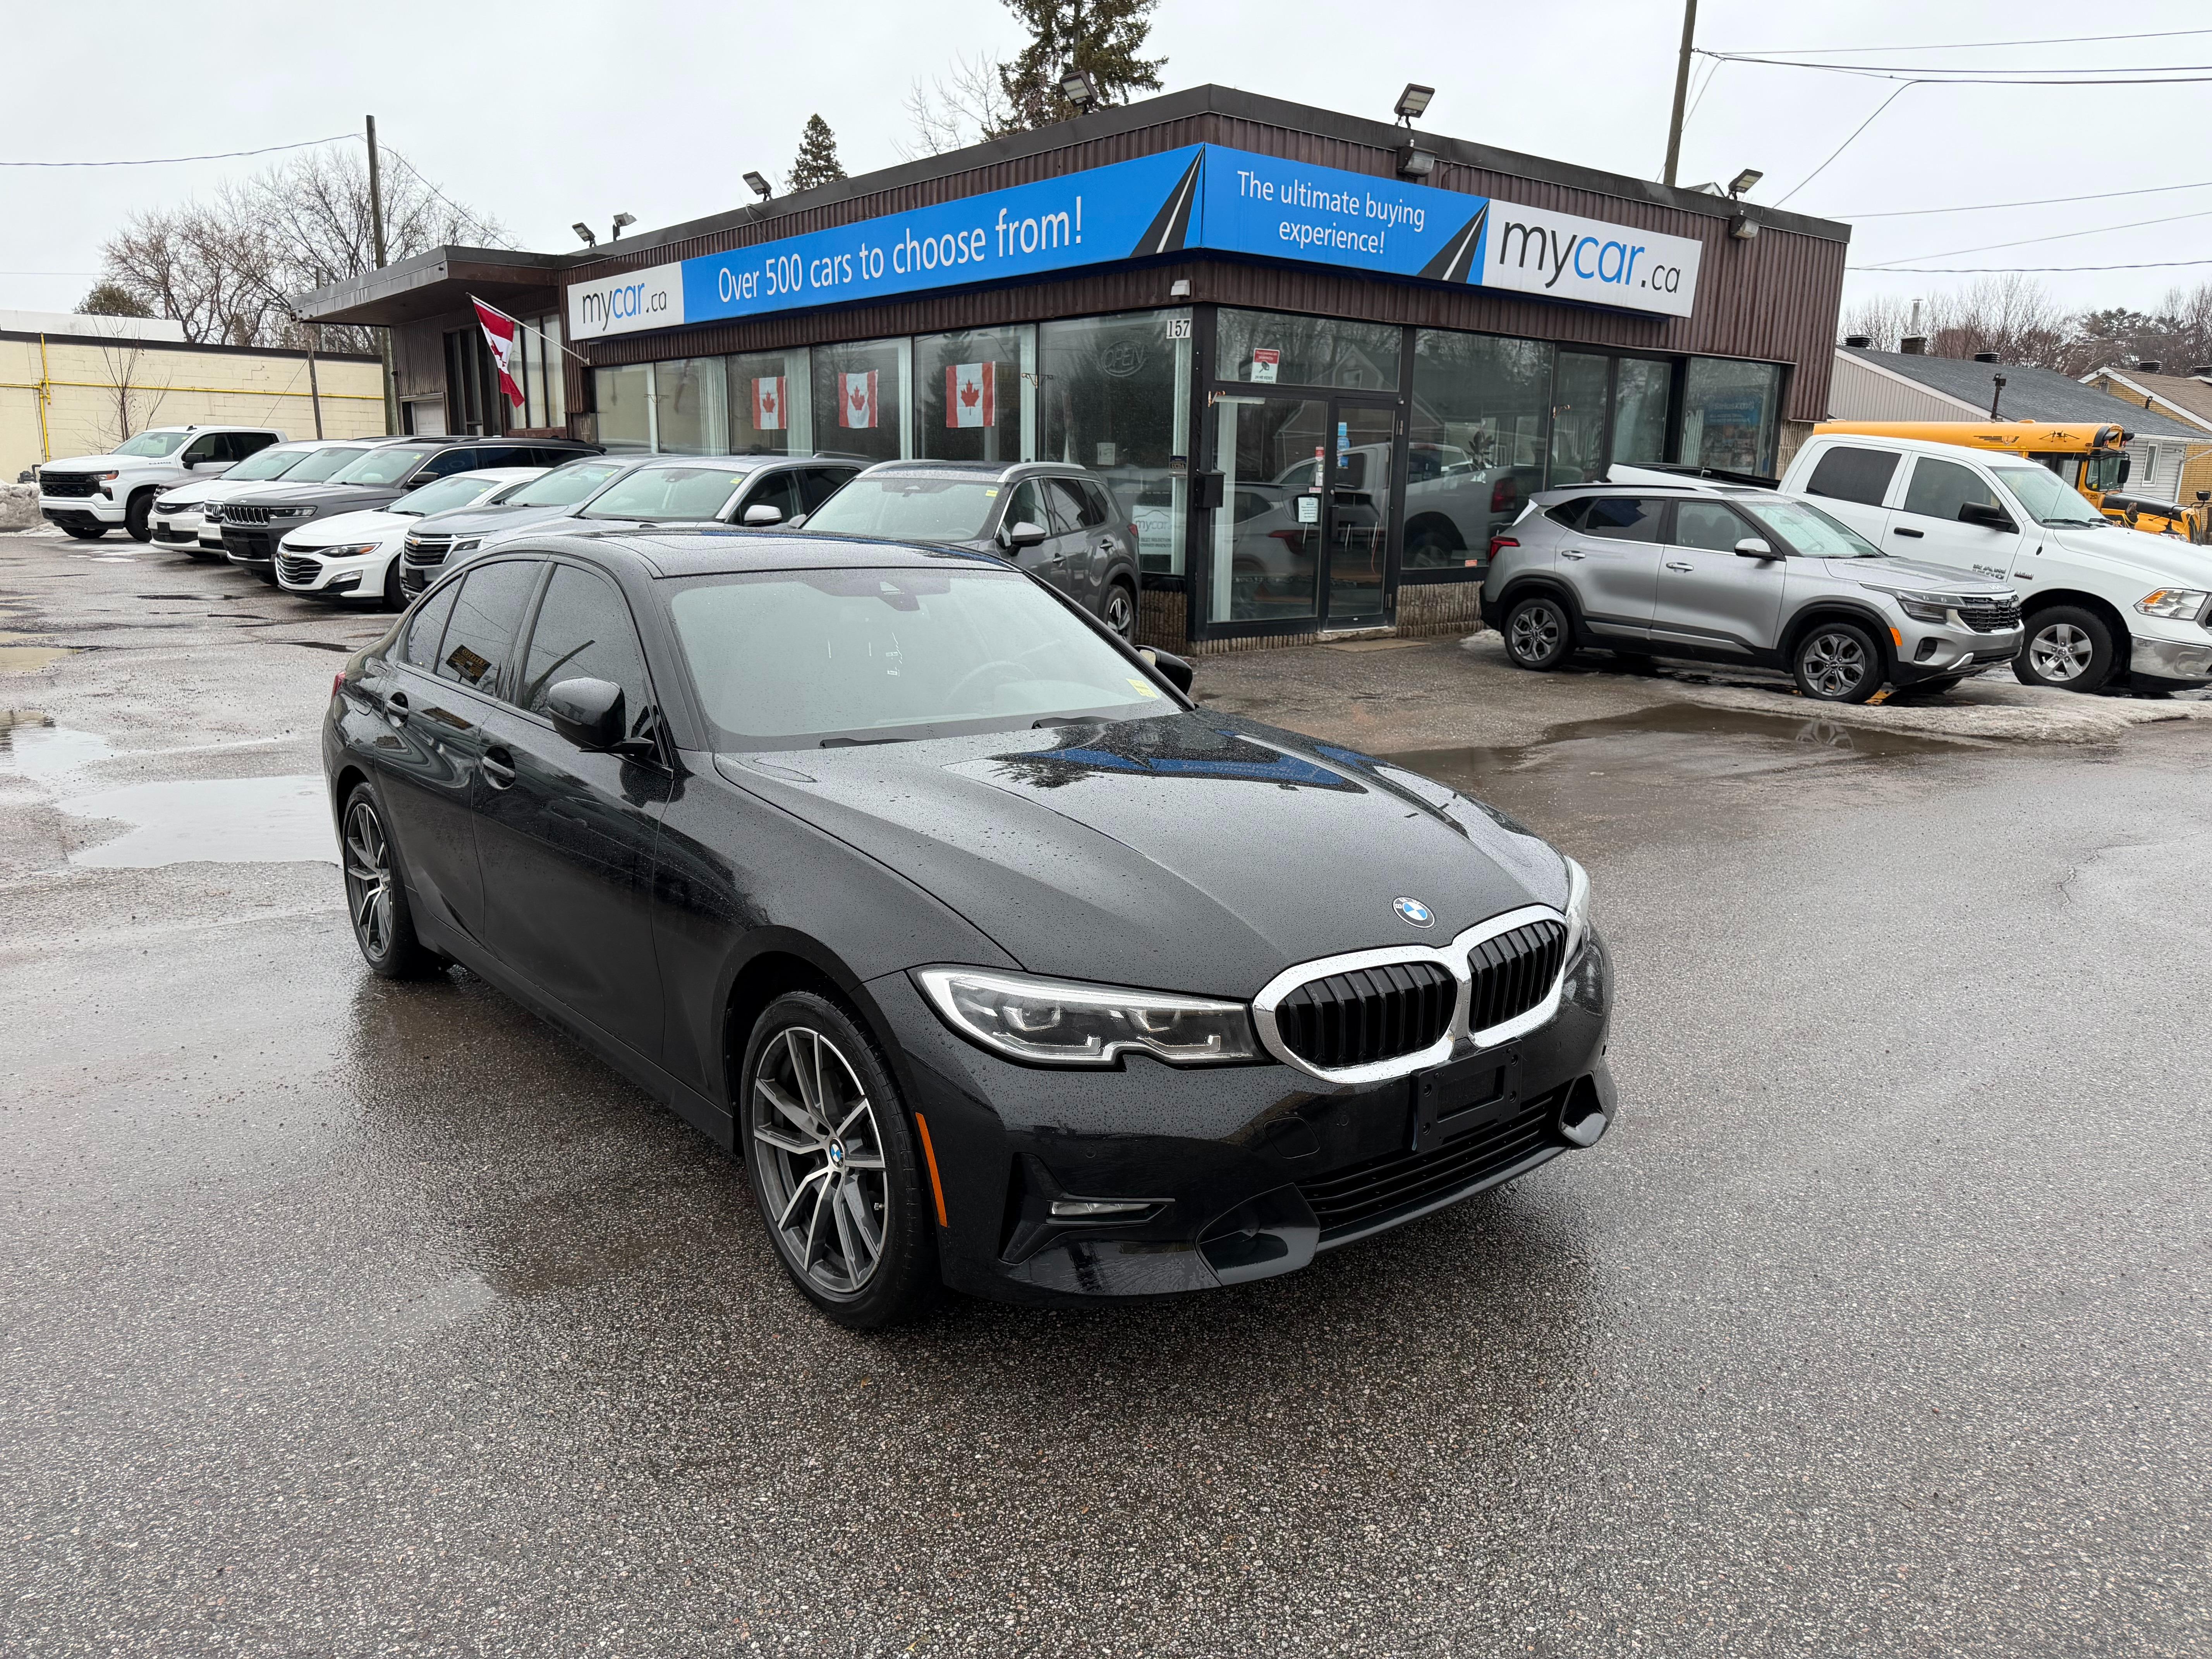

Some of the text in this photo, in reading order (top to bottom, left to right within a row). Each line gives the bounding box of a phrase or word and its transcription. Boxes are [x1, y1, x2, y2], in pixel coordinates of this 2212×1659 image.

[1237, 170, 1425, 232] The ultimate buying
[718, 196, 1081, 302] Over 500 cars to choose from!
[1279, 221, 1384, 254] experience!
[1499, 222, 1681, 293] mycar.ca
[582, 283, 667, 332] mycar.ca
[1169, 320, 1190, 337] 157
[1104, 344, 1144, 368] OPEN
[1973, 564, 2006, 574] RAM
